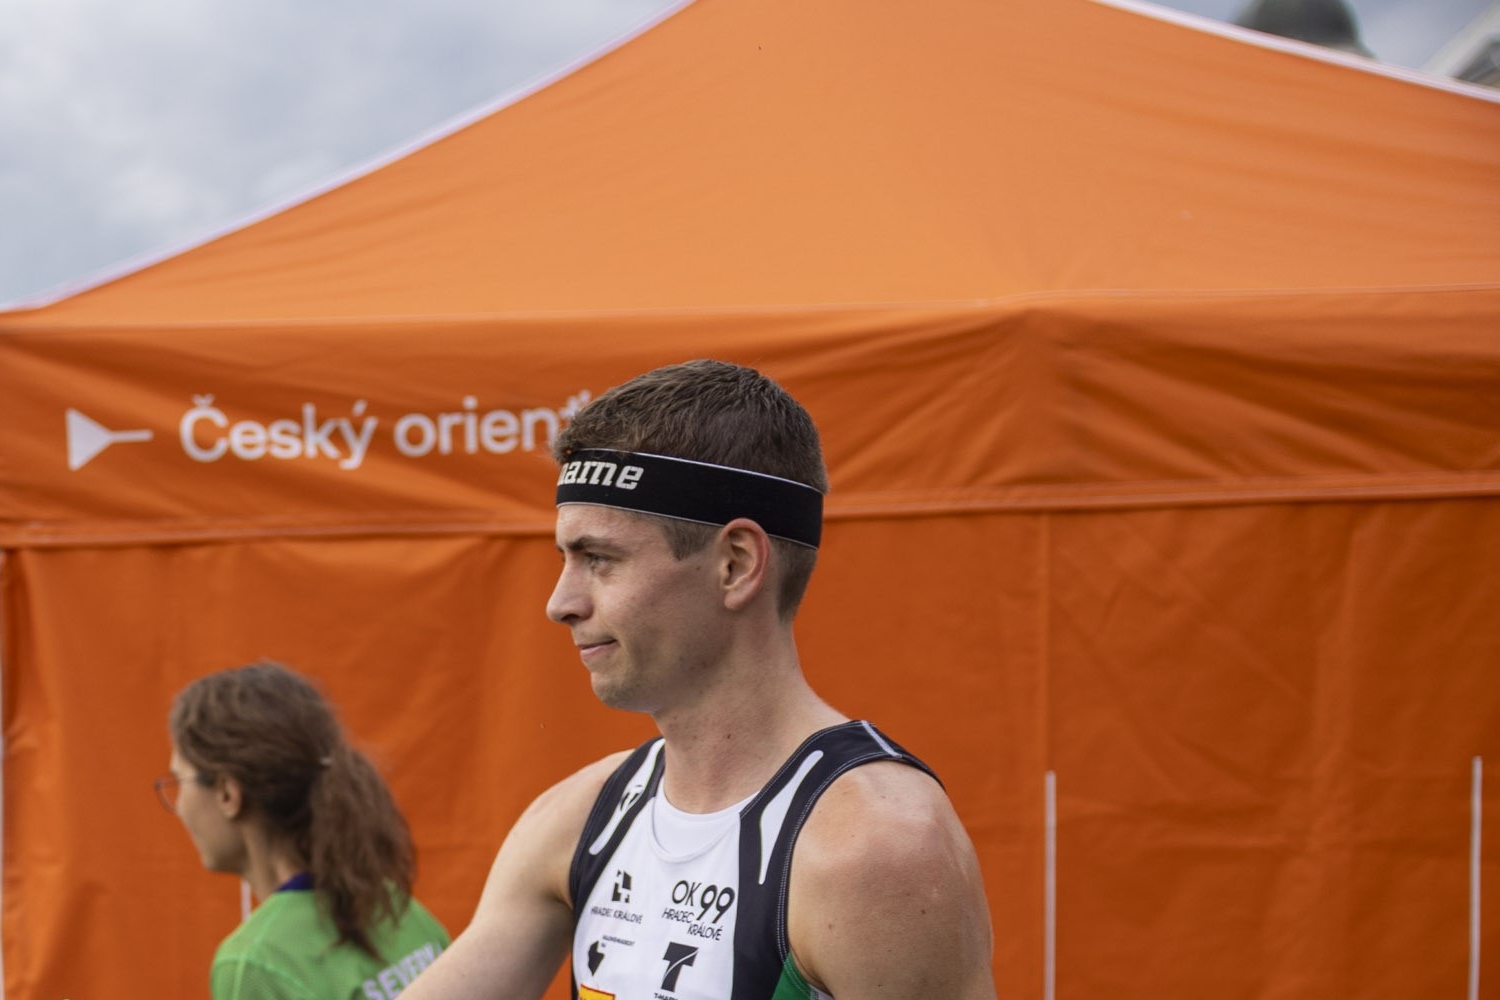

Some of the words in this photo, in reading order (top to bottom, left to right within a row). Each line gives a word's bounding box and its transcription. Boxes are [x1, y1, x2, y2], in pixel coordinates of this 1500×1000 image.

[180, 394, 378, 470] Český
[661, 907, 695, 923] HRADEC
[687, 922, 723, 940] KRÁLOVÉ
